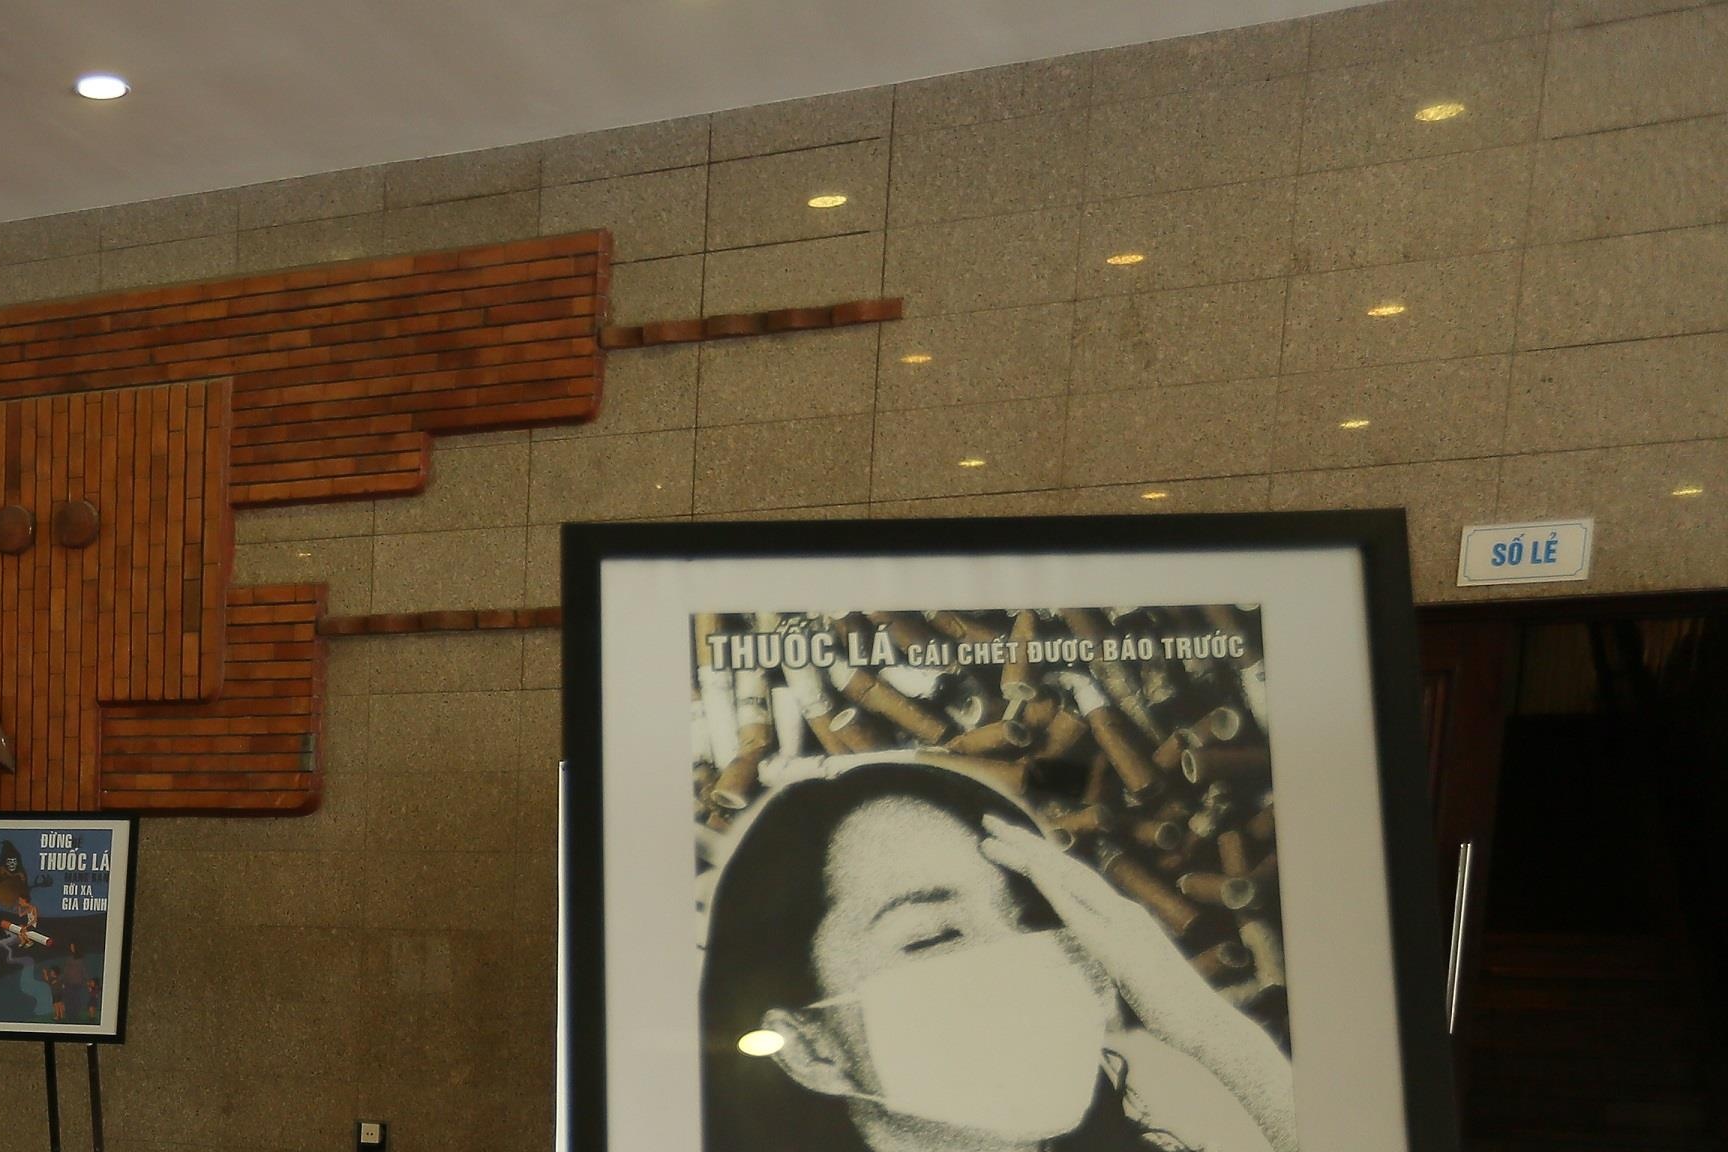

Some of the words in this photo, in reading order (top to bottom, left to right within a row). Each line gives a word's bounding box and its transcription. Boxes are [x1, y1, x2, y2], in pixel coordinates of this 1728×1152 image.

[1491, 533, 1525, 566] SỐ
[1530, 532, 1558, 564] LẺ
[707, 618, 834, 671] THUỐC
[848, 623, 896, 667] LÁ
[907, 639, 949, 666] CÁI
[957, 634, 1018, 665] CHẾT
[1027, 638, 1095, 667] ĐƯỢC
[1103, 634, 1153, 662] BÁO
[1160, 630, 1245, 660] TRƯỚC
[40, 831, 73, 849] ĐỪNG
[39, 847, 87, 871] THUỐC
[92, 850, 110, 871] LÁ
[80, 884, 92, 896] XA
[62, 897, 79, 911] GIA
[83, 896, 108, 911] ĐÌNH
